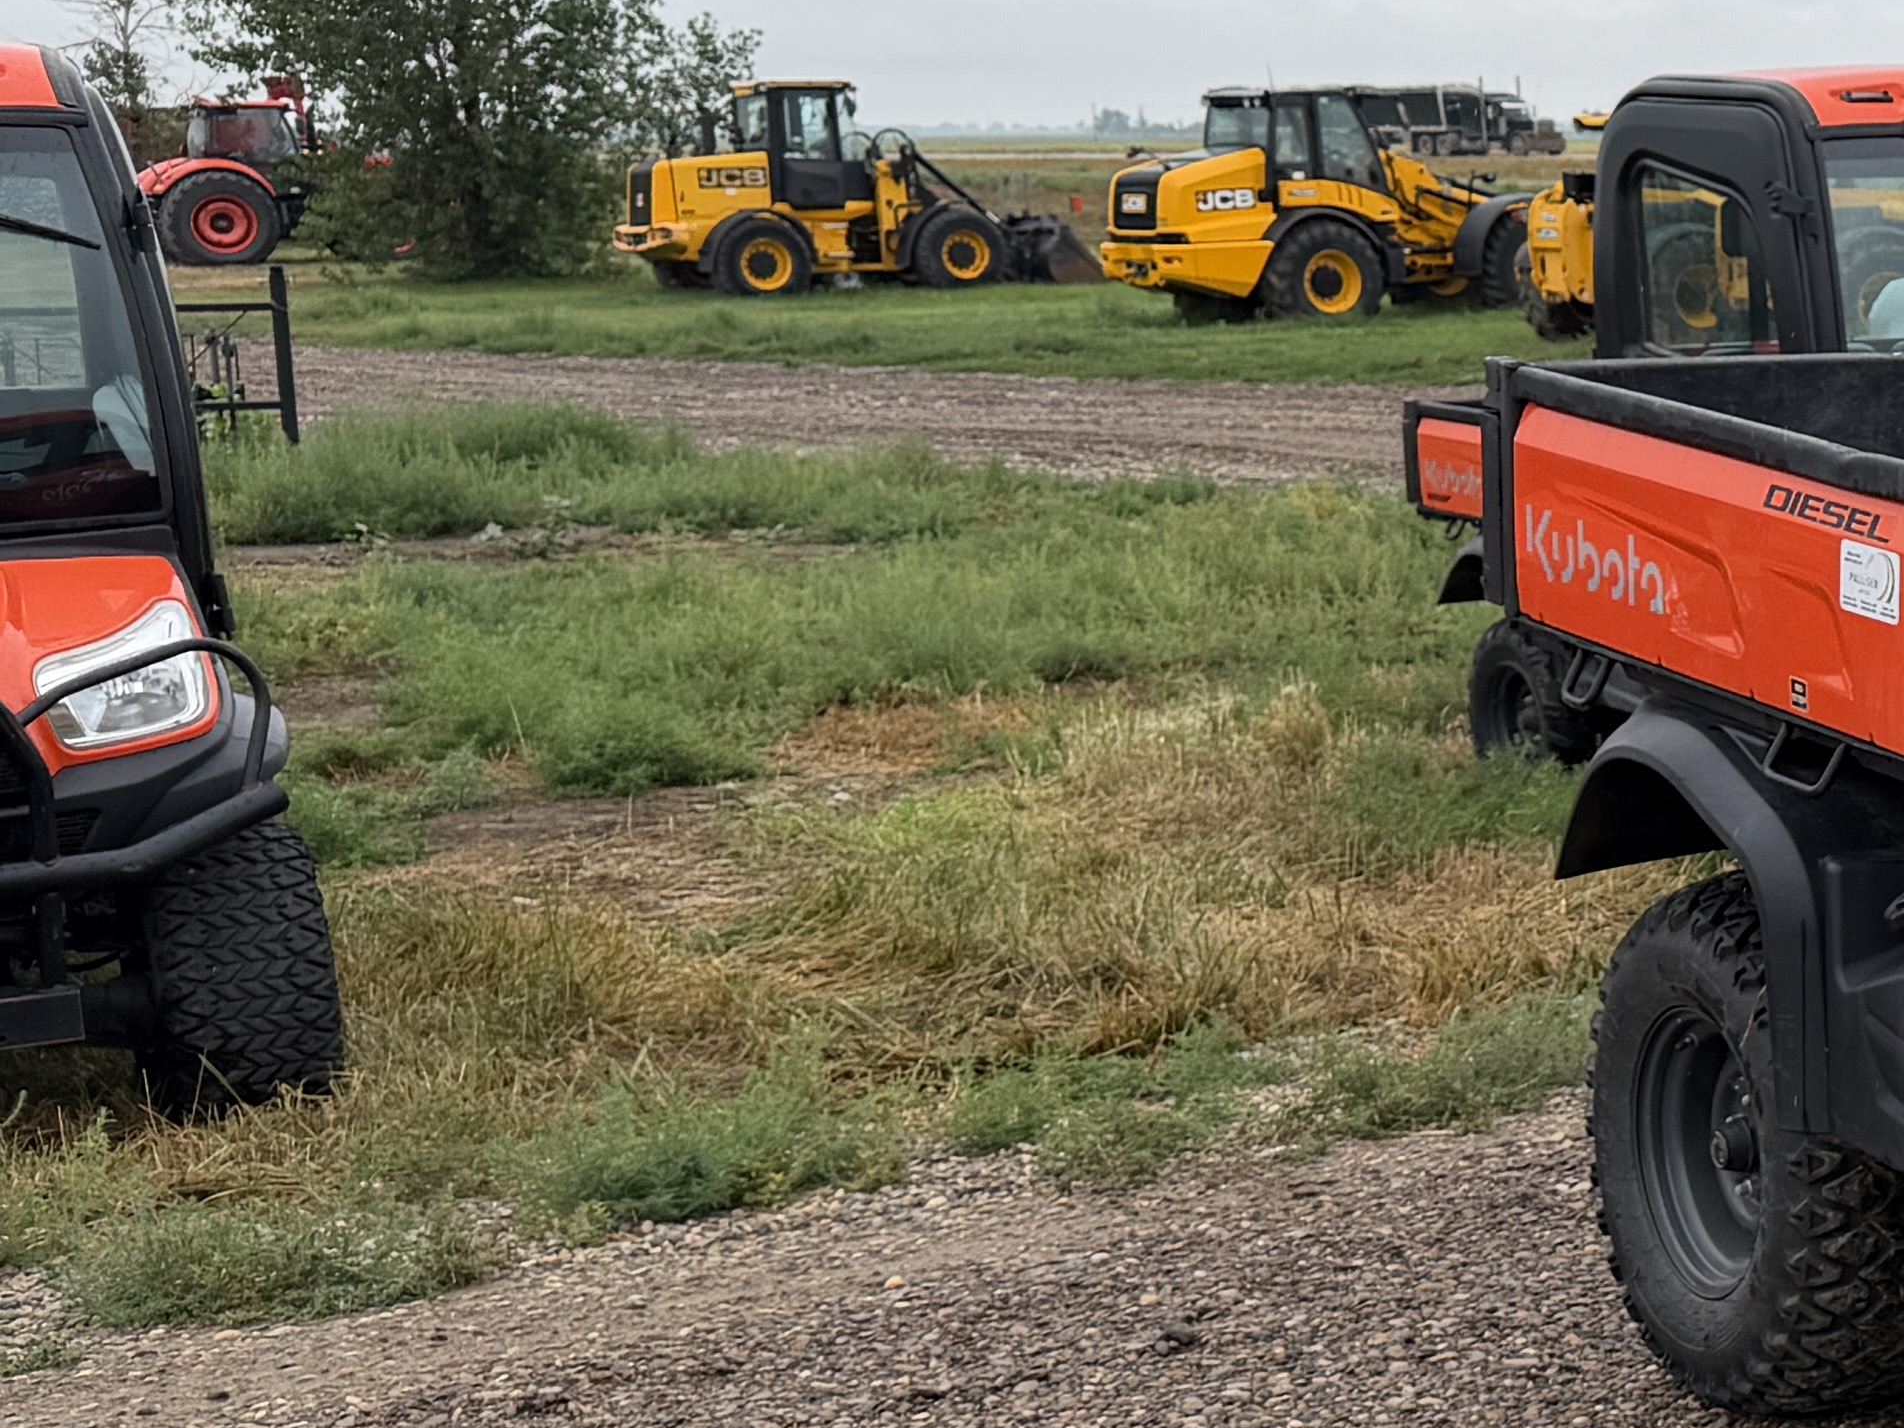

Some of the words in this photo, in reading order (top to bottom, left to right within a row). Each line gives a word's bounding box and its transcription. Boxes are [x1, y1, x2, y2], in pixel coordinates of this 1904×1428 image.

[699, 168, 766, 187] JCB
[1197, 188, 1256, 212] JCB
[1762, 483, 1890, 544] DIESEL
[1525, 503, 1665, 615] Kubota
